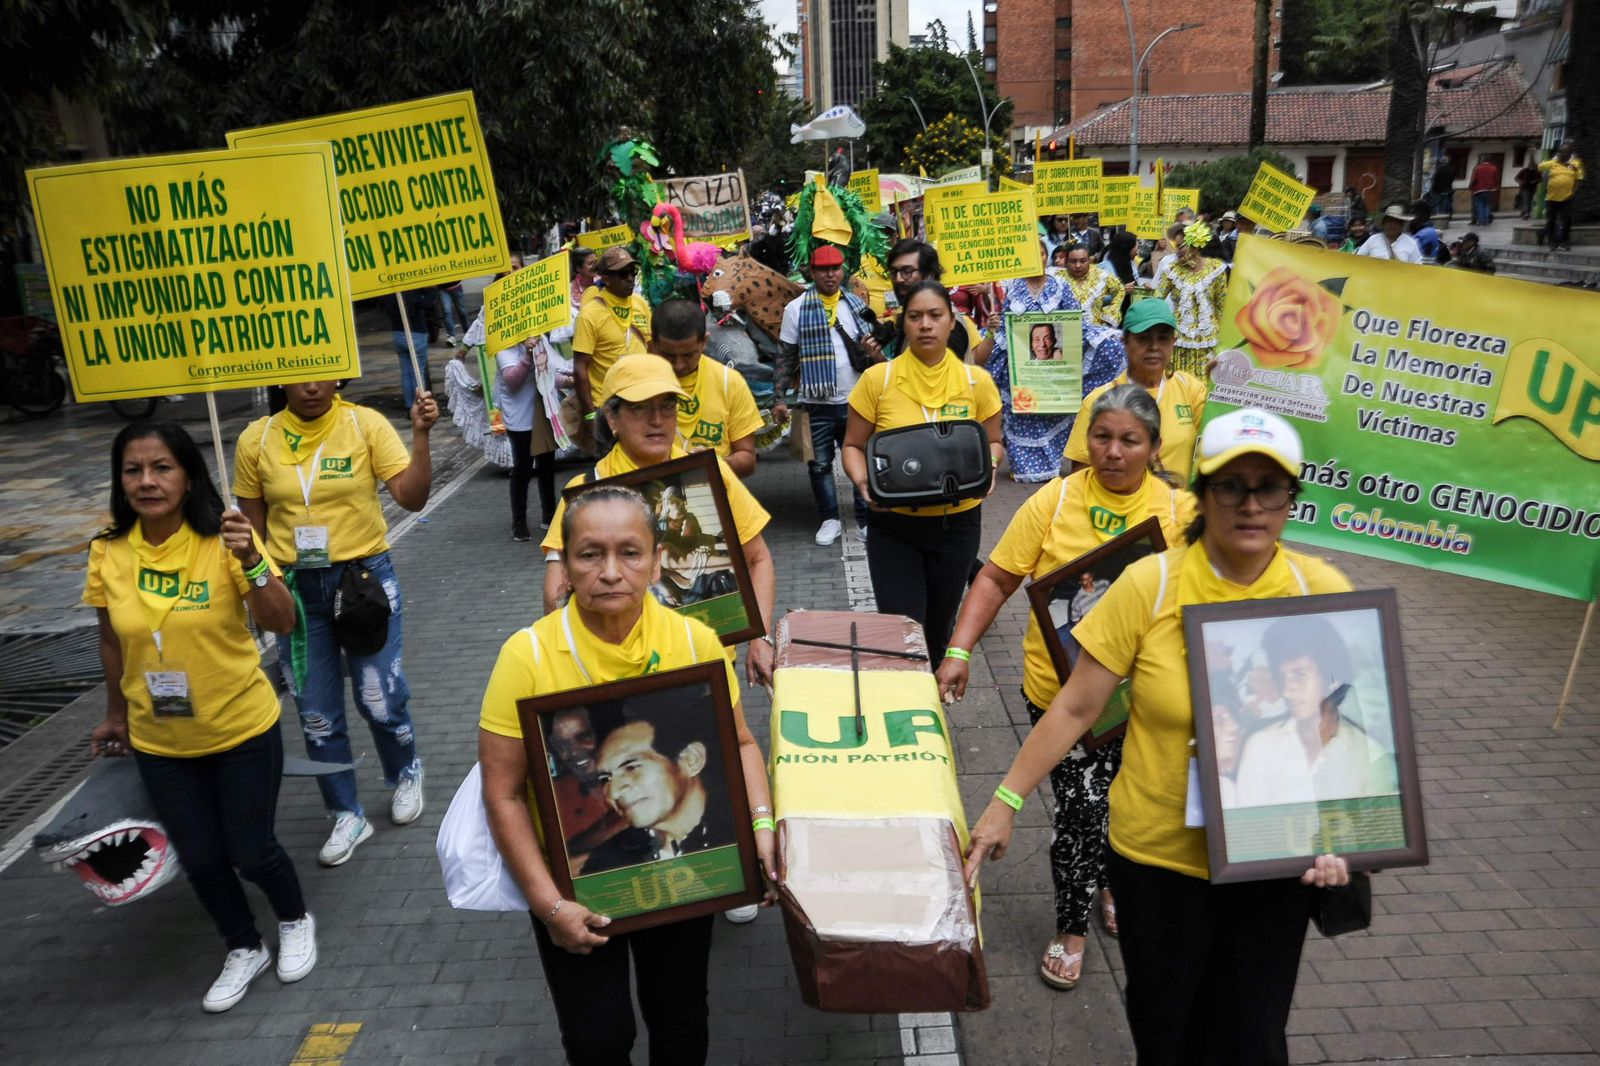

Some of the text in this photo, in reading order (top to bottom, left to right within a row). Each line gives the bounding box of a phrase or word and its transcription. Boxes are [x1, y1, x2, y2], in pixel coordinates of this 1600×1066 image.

[1036, 183, 1045, 194] DEL
[1076, 180, 1098, 192] CONTRA
[1037, 165, 1098, 180] SOY SOBREVIVIENTE
[125, 171, 228, 225] NO MÁS
[339, 165, 485, 226] OCIDIO CONTRA
[941, 207, 949, 220] 11
[953, 205, 968, 219] DE
[973, 200, 1024, 217] OCTUBRE
[1036, 196, 1044, 208] LA
[958, 218, 994, 229] NACIONAL
[996, 215, 1010, 224] POR
[1013, 215, 1023, 223] LA
[972, 229, 980, 238] DE
[983, 227, 995, 236] LAS
[80, 212, 294, 276] ESTIGMATIZACIÓN
[378, 211, 495, 267] PATRIÓTICA
[944, 235, 1027, 252] DEL GENOCIDIO CONTRA
[378, 254, 499, 284] Corporación Reiniciar
[957, 251, 972, 262] LA
[490, 270, 560, 310] ES RESPONSABLE
[503, 263, 546, 290] EL ESTADO
[62, 262, 334, 323] NI IMPUNIDAD CONTRA
[494, 284, 555, 320] DEL GENOCIDIO
[487, 313, 518, 335] CONTRA
[520, 306, 531, 319] LA
[1352, 309, 1507, 355] Que Florezca
[79, 305, 331, 367] LA UNIÓN PATRIÓTICA
[188, 354, 341, 378] Corporación Reiniciar
[1351, 343, 1493, 387] La Memoria
[1208, 393, 1242, 405] Promoción
[1264, 403, 1295, 415] Derechos
[1296, 410, 1326, 421] Humanos
[1260, 394, 1276, 402] para
[1342, 374, 1487, 419] De Nuestras
[1526, 349, 1600, 440] UP
[697, 423, 719, 438] UP
[1358, 408, 1457, 446] Víctimas
[326, 459, 347, 470] UP
[1357, 474, 1421, 504] otro
[1430, 484, 1600, 538] GENOCIDIO
[1094, 510, 1122, 533] UP
[1331, 503, 1472, 554] Colombia
[144, 573, 175, 594] UP
[780, 709, 947, 750] UP
[631, 866, 695, 910] UP
